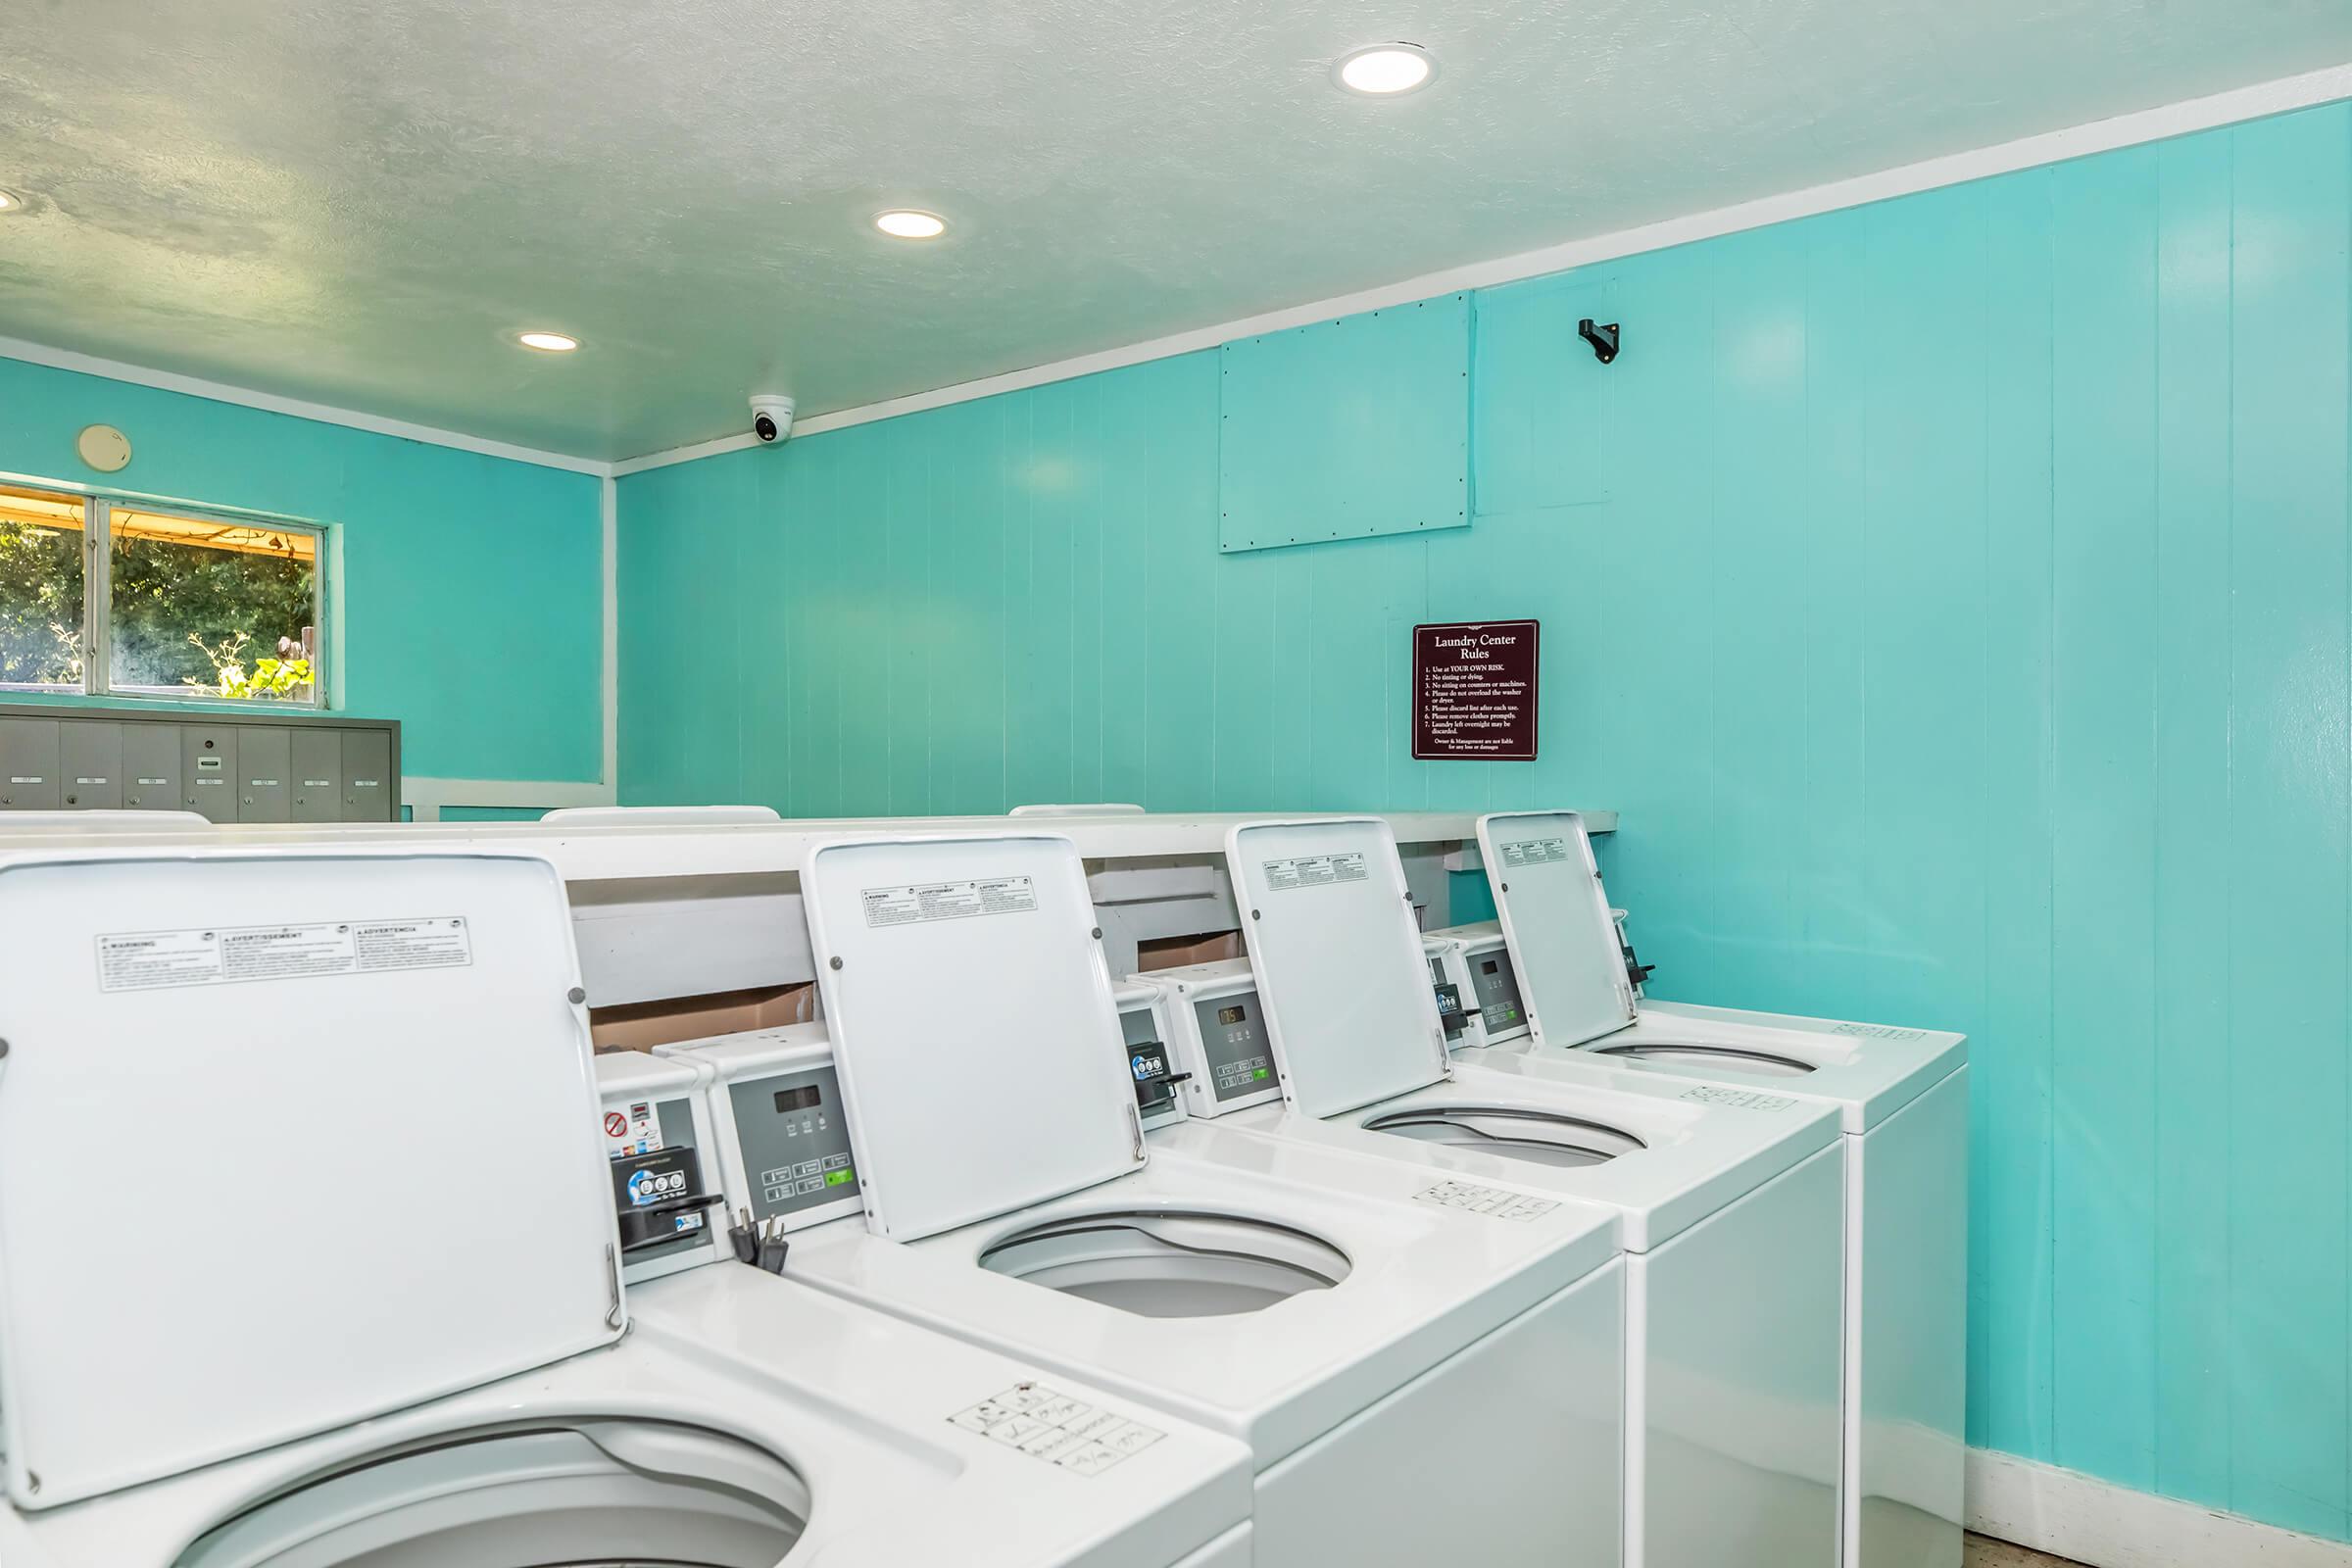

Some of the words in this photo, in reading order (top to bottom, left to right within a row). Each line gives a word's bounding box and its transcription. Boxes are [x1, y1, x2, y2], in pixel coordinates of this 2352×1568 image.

[1435, 636, 1477, 648] Laundry
[1480, 634, 1516, 646] Center
[1461, 648, 1490, 660] Rules
[1490, 711, 1516, 720] promptly.
[364, 926, 416, 935] ADVERTENCIA
[231, 932, 303, 942] AVERTISSEMENT
